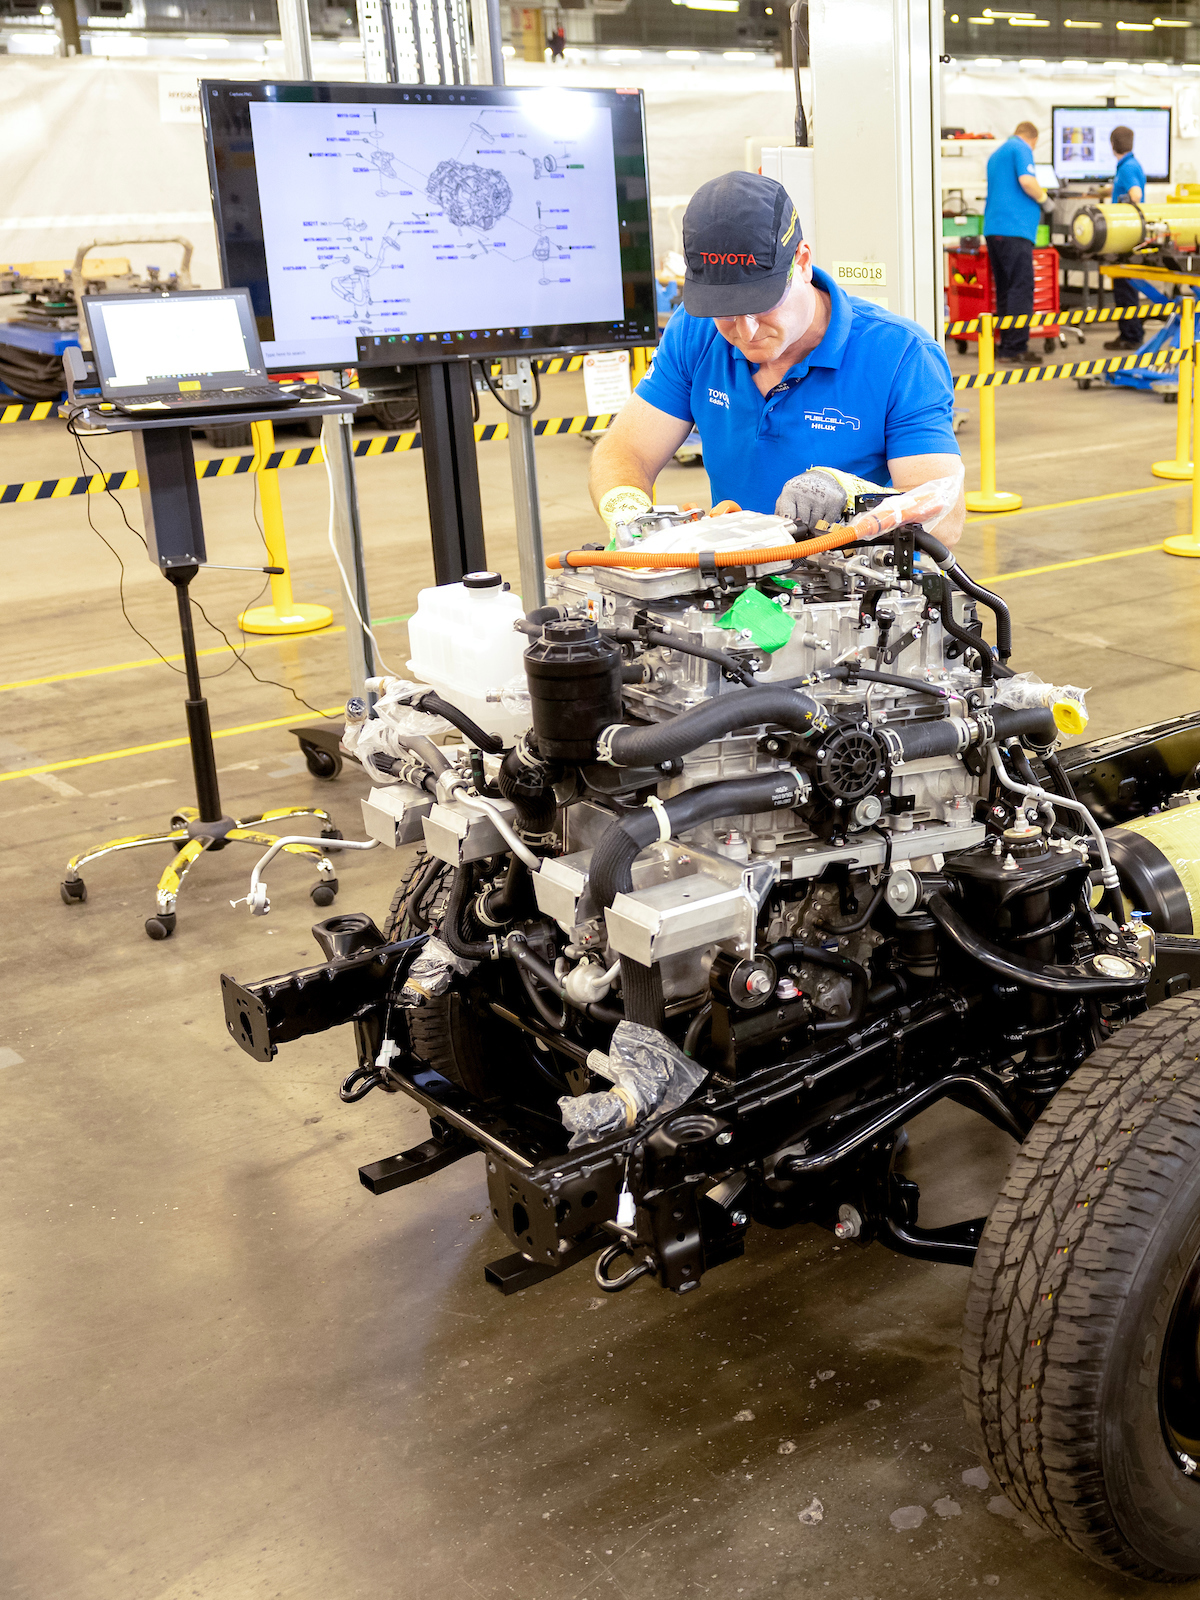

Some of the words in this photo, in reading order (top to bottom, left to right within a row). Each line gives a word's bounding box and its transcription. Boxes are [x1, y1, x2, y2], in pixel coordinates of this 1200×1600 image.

[168, 91, 198, 99] HYDRA
[700, 252, 757, 266] TOYOTA
[838, 266, 883, 279] BBG018
[804, 415, 846, 425] FUELCELL
[811, 423, 836, 432] HILUX
